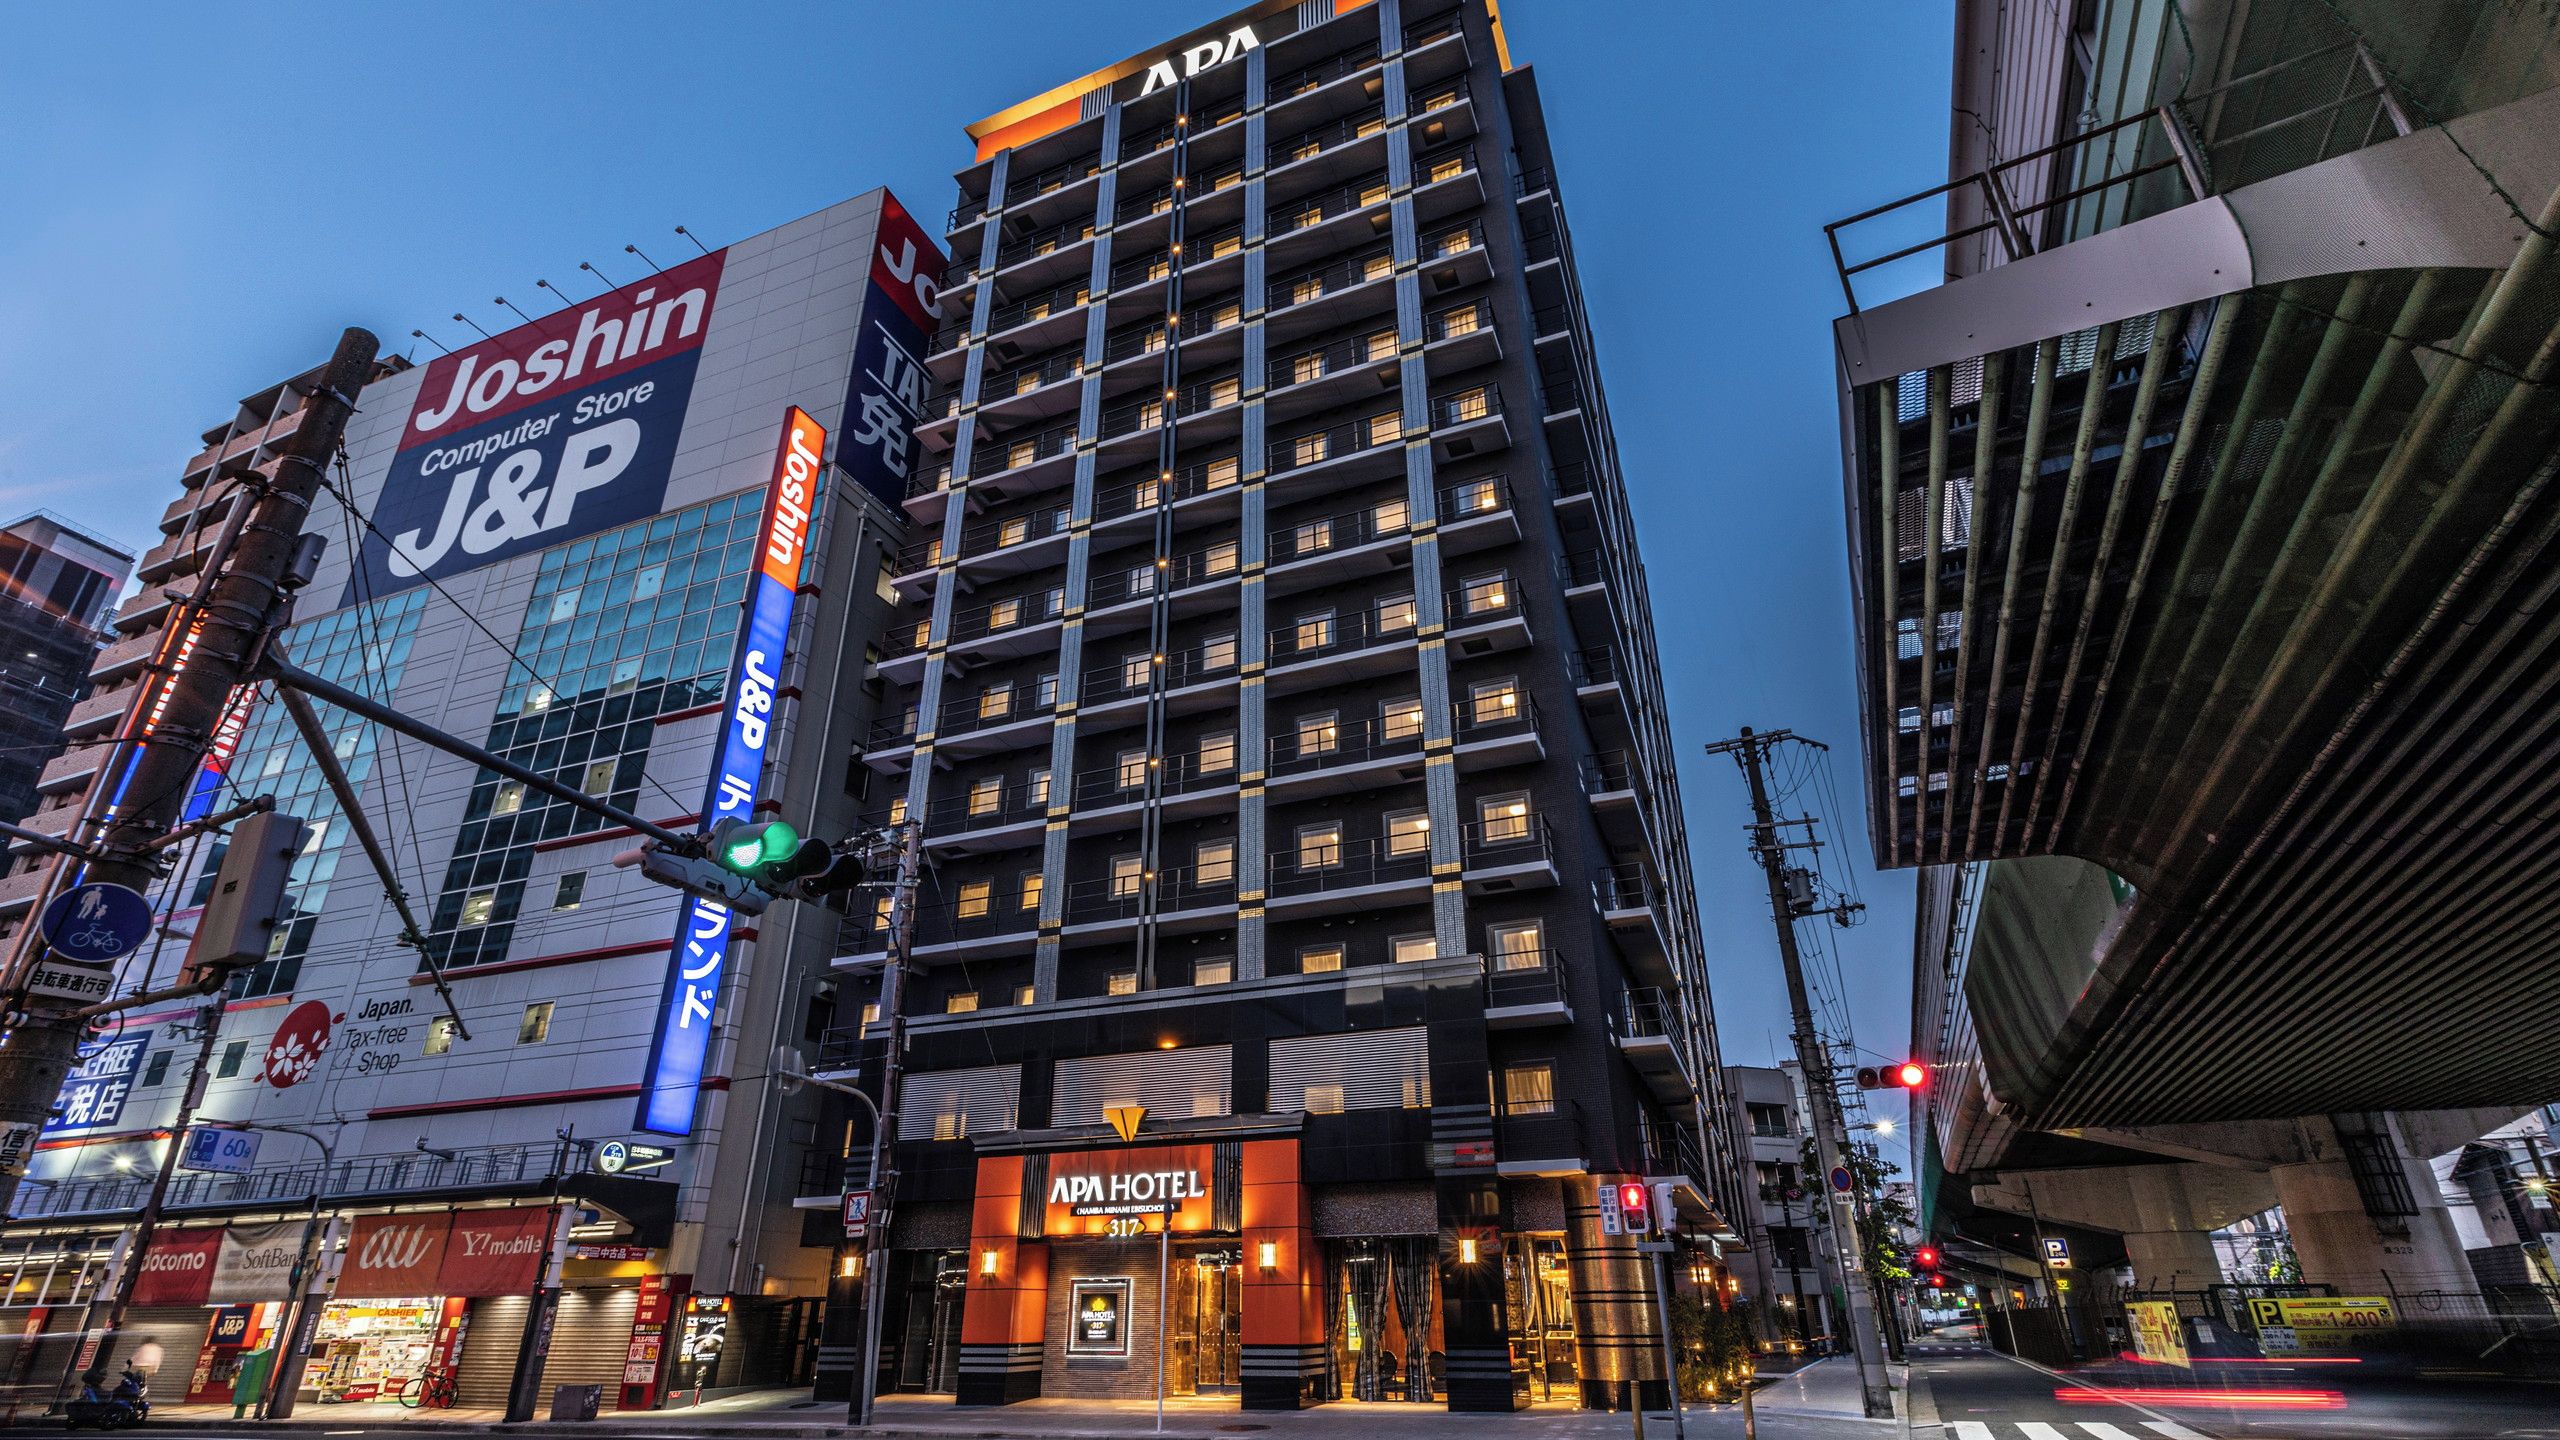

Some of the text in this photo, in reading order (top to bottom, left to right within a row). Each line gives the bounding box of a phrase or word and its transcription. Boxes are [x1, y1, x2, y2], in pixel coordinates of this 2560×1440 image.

[1140, 25, 1260, 97] APA
[415, 287, 707, 432] Joshin
[420, 381, 655, 477] Computer Store
[388, 418, 641, 578] J&P
[768, 428, 818, 566] Joshin
[737, 650, 775, 750] J&P
[31, 970, 111, 995] 自転車通行可
[358, 998, 415, 1021] Japan.
[346, 1025, 408, 1049] Tax-free
[358, 1051, 400, 1074] Shop
[200, 1133, 215, 1150] P
[1049, 1170, 1205, 1204] APA HOTEL
[1108, 1218, 1140, 1237] 317
[359, 1224, 434, 1270] au
[600, 1246, 627, 1259] 中古品
[2046, 1241, 2062, 1257] P
[243, 1248, 301, 1270] SoftBan
[377, 1308, 418, 1317] CASHIER
[1095, 1311, 1116, 1319] HOTEL
[2257, 1302, 2278, 1324] P
[2327, 1311, 2380, 1328] 1,200
[217, 1318, 246, 1336] J&P
